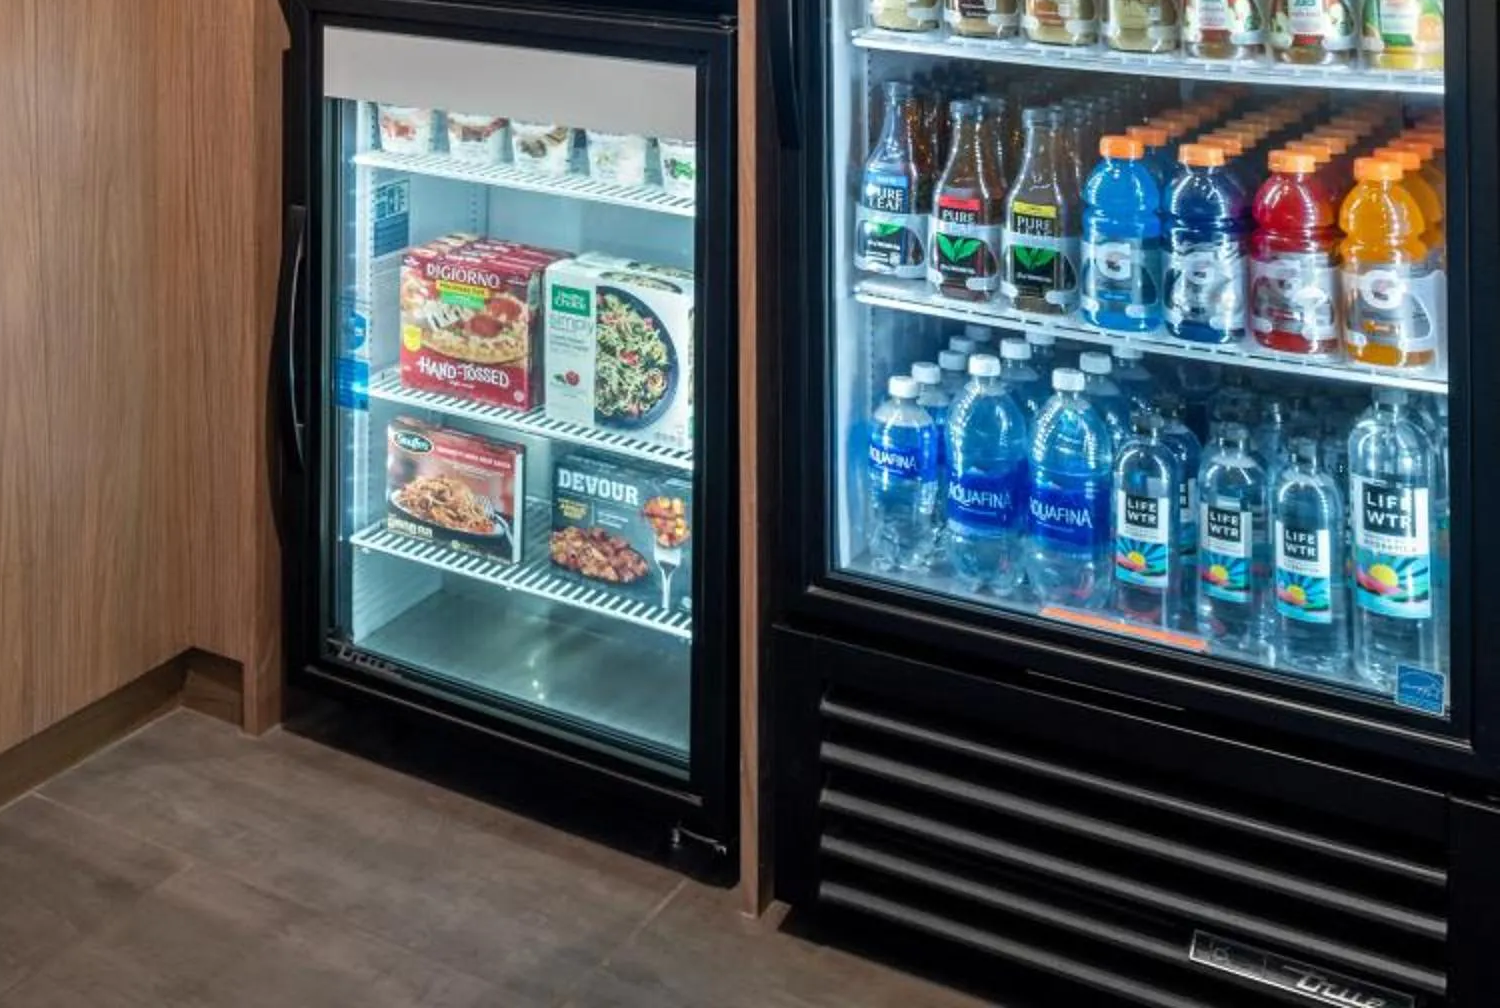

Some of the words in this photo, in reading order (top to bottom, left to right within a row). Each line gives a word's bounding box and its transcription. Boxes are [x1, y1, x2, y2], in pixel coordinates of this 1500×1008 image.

[1017, 215, 1051, 231] PURE
[426, 262, 501, 289] DIGIORNO
[419, 354, 510, 389] HAND-TOSSED
[558, 467, 638, 507] DEVOUR
[1126, 500, 1157, 515] LIFE
[1366, 490, 1412, 513] LIFE
[1127, 511, 1158, 526] WTR
[1209, 511, 1239, 527] LIFE
[1366, 508, 1412, 528] WTR
[1209, 523, 1240, 539] WTR
[1285, 529, 1315, 544] LIFE
[1285, 542, 1317, 558] WTR
